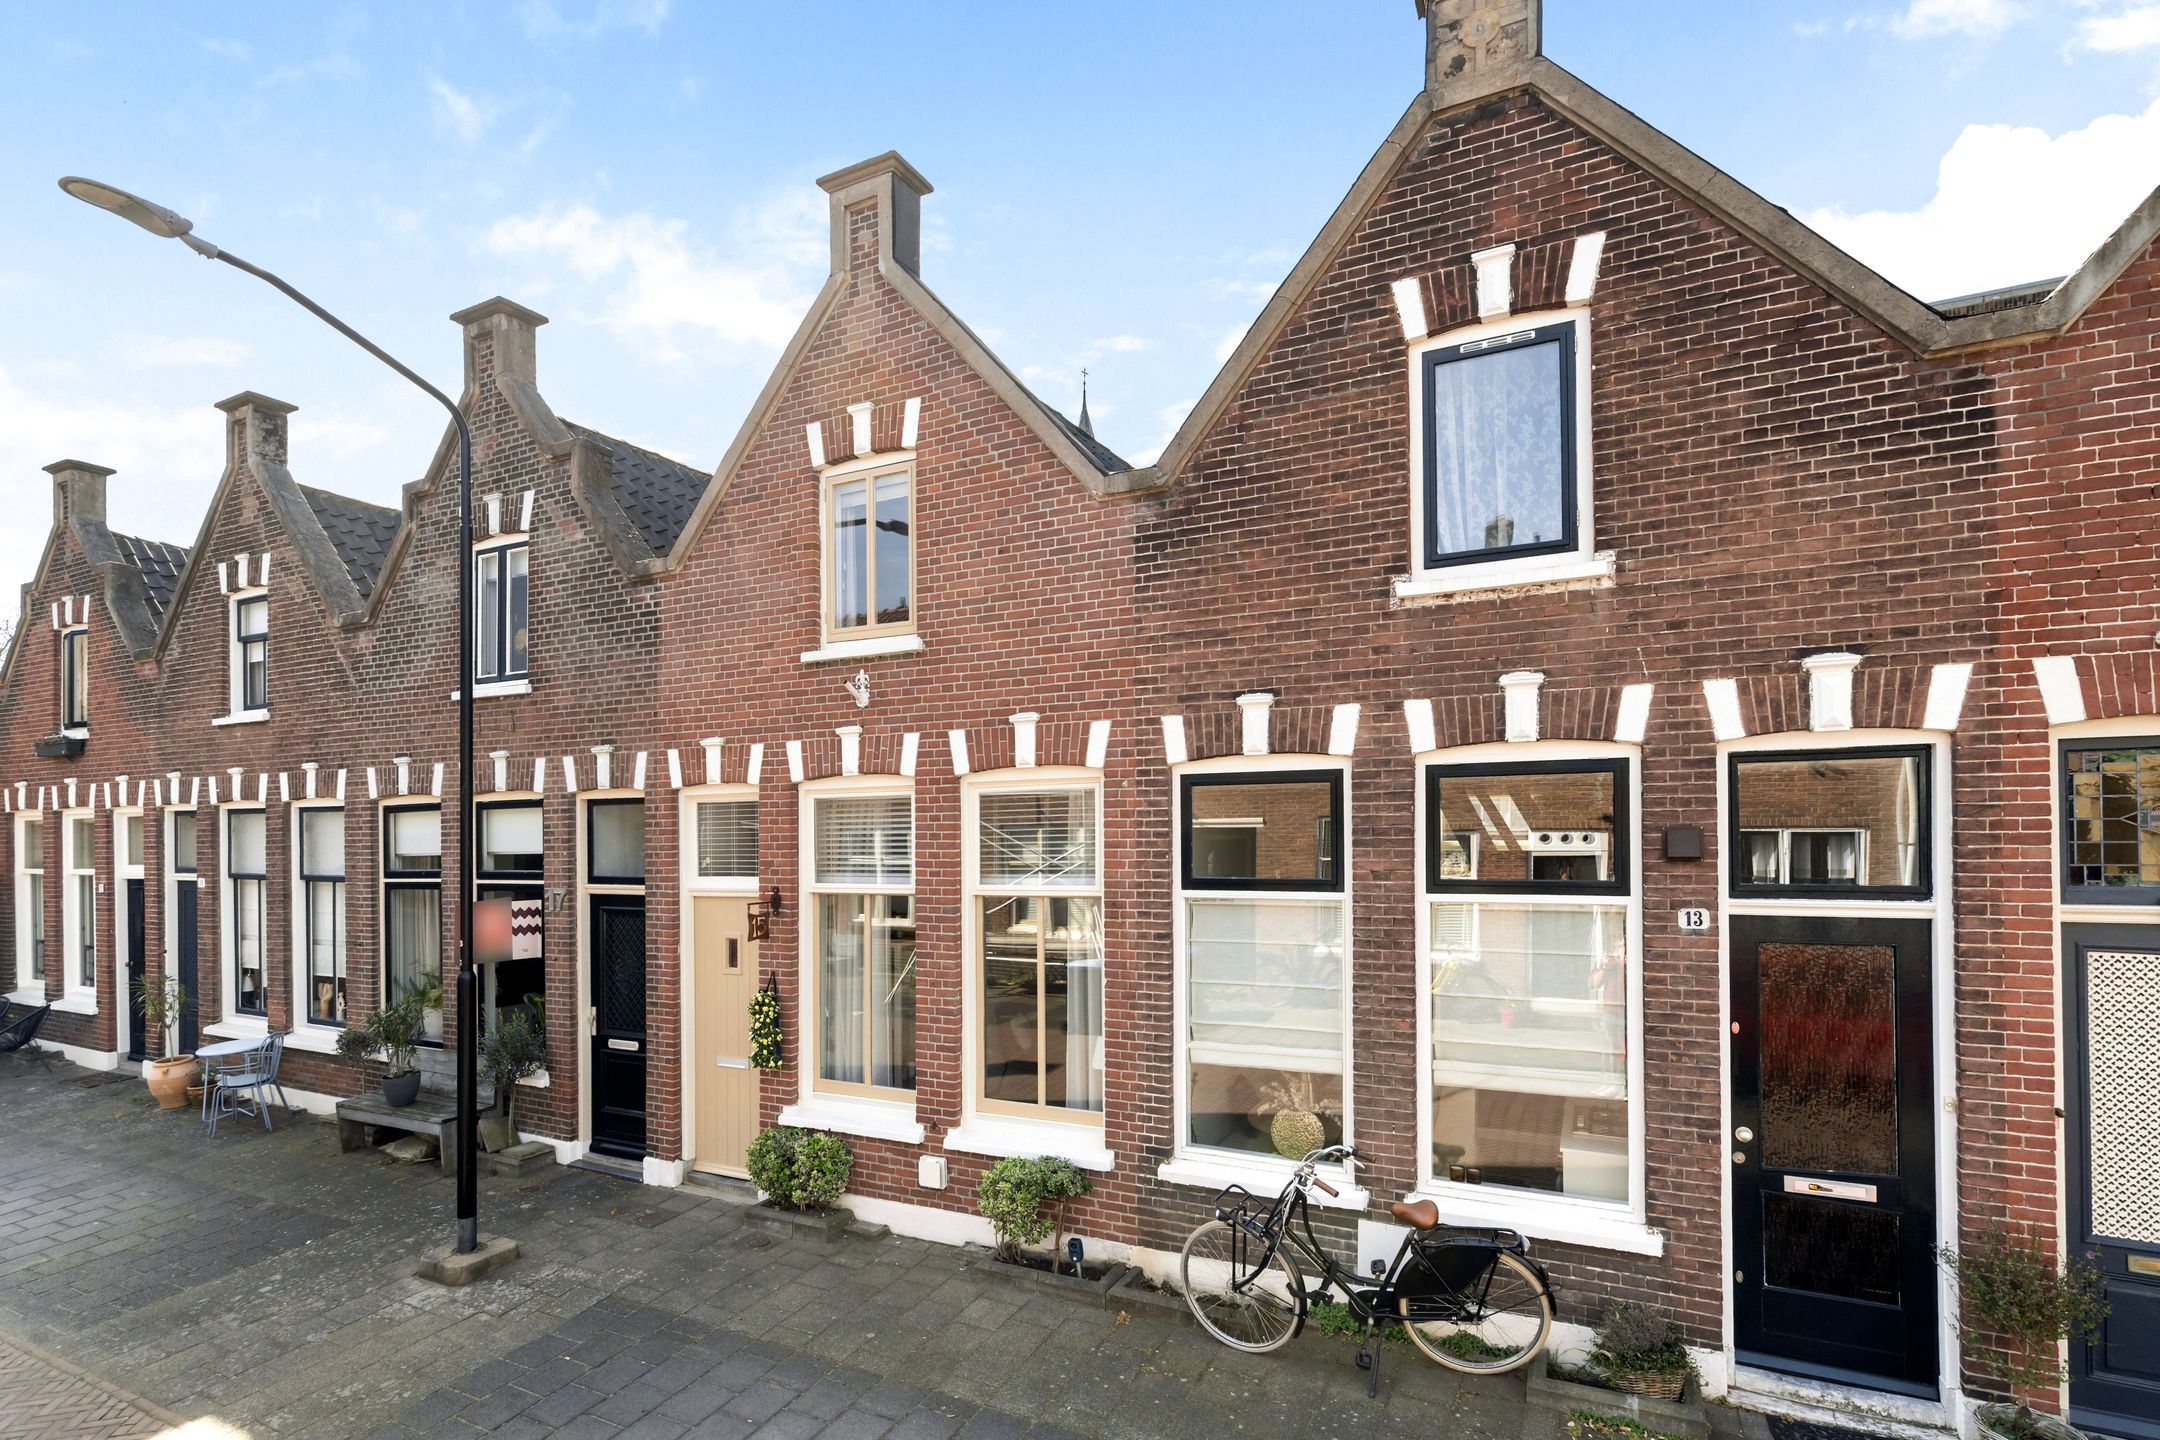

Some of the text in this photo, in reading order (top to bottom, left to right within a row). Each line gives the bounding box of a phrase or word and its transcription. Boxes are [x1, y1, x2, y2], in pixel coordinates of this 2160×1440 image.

[544, 887, 566, 911] 17
[752, 916, 766, 938] 15
[1685, 910, 1703, 927] 13
